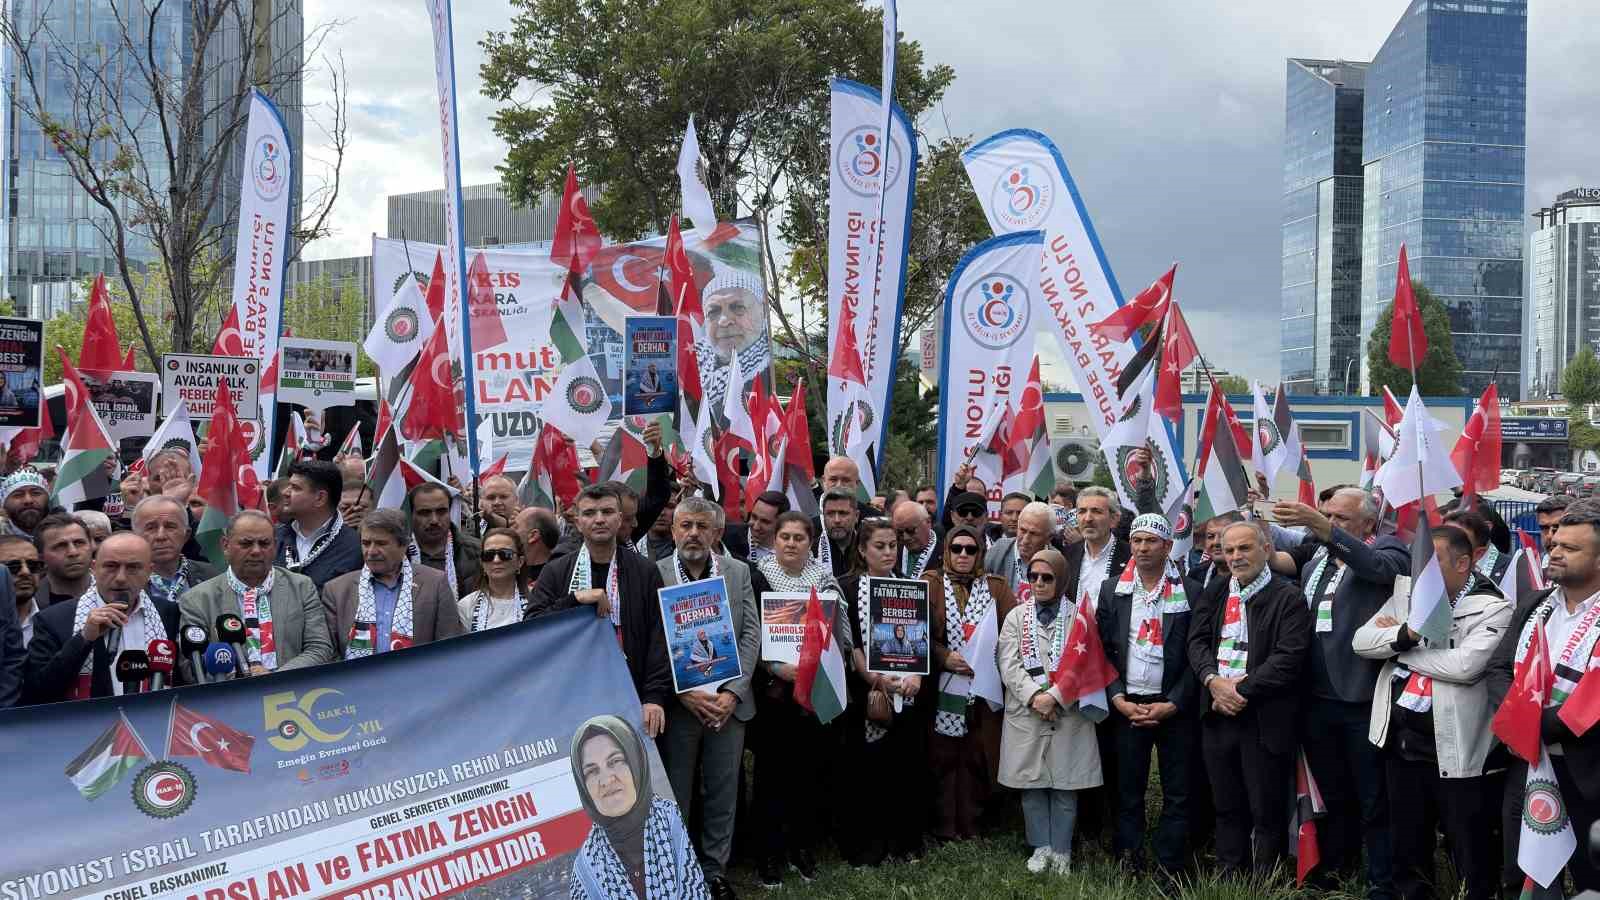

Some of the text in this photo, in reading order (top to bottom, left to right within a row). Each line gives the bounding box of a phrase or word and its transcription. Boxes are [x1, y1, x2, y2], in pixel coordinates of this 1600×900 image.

[471, 293, 518, 304] KARA
[638, 342, 666, 353] DERHAL
[186, 360, 239, 374] İNSANLIK
[477, 347, 556, 371] mut
[175, 373, 212, 387] AYAĞA
[479, 377, 558, 403] LAN
[95, 401, 112, 412] ATİL
[967, 369, 986, 438] NO'LU
[874, 587, 898, 598] FATMA
[680, 607, 716, 623] DERHAL
[882, 608, 917, 618] SERBEST
[277, 736, 387, 769] Emeğin Evrensel Gücü
[200, 800, 330, 852] TARAFINDAN
[334, 768, 449, 815] HUKUKSUZCA
[453, 754, 500, 782] REHİN
[505, 737, 558, 768] ALINAN
[370, 779, 510, 830] GENEL SEKRETER YARDIMCIMIZ
[315, 854, 351, 886] ve
[356, 821, 448, 873] FATMA
[448, 791, 538, 843] ZENGİN
[150, 861, 230, 895] BAŞKANIMIZ
